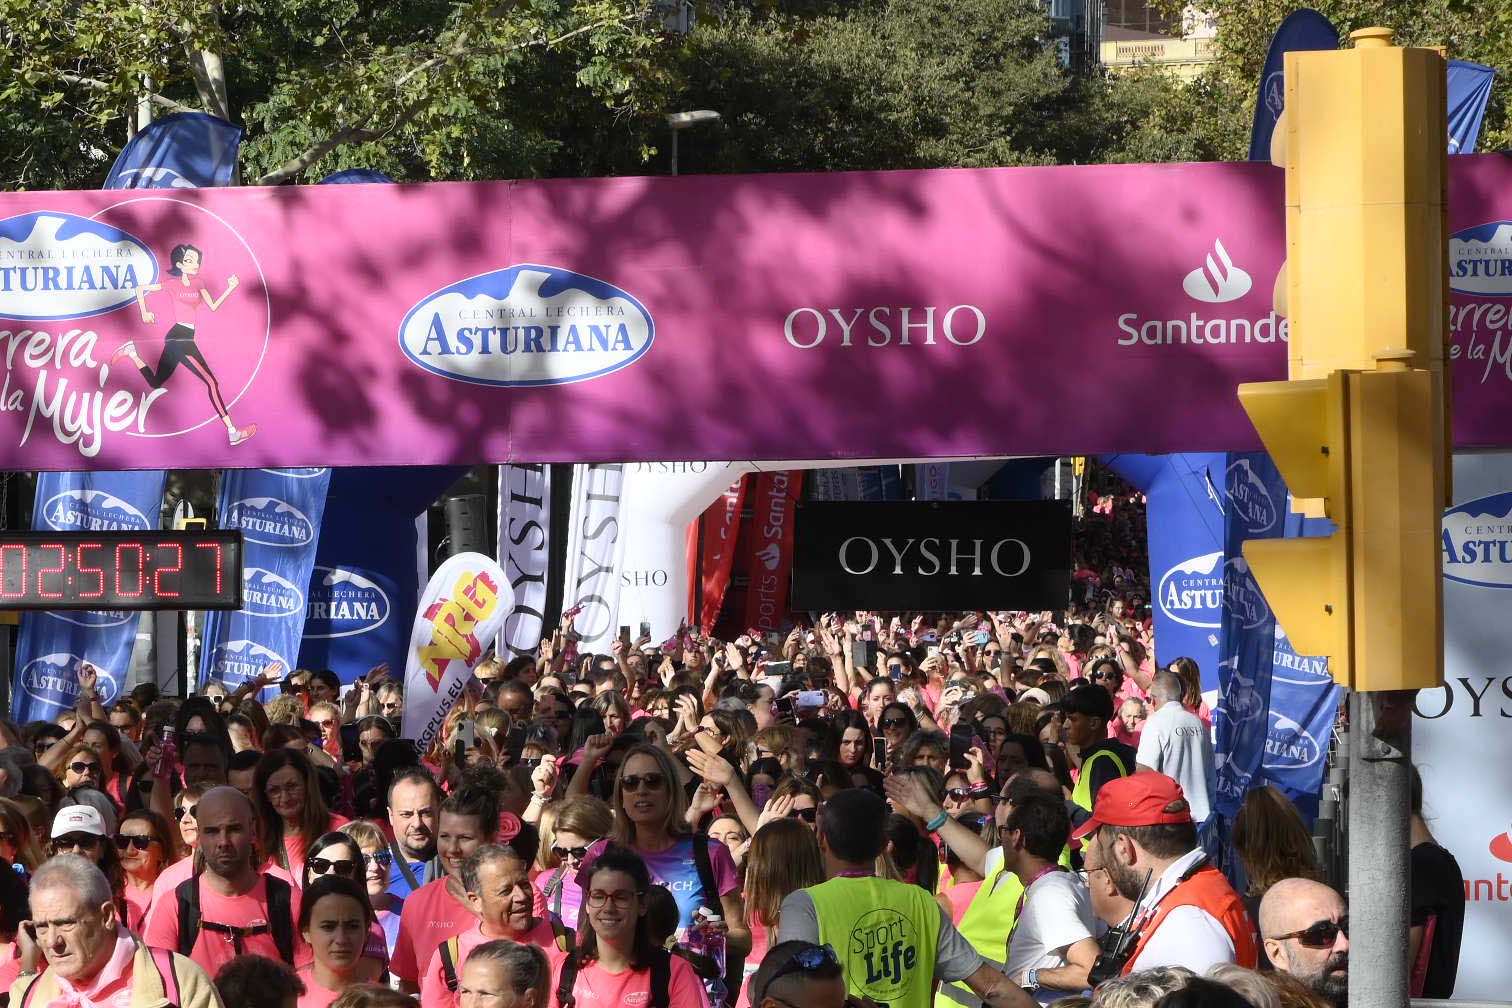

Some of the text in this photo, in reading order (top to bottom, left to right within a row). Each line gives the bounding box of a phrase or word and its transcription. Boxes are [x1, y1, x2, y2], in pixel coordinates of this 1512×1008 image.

[62, 248, 133, 259] LECHERA
[459, 306, 625, 319] CENTRAL LECHERA
[784, 304, 986, 349] OYSHO
[419, 312, 633, 355] ASTURIANA
[1118, 313, 1288, 346] Santande
[0, 372, 25, 412] la
[19, 370, 168, 457] Mujer
[229, 509, 307, 540] ASTURIANA
[1465, 526, 1512, 534] CENTR
[504, 463, 545, 657] OYSH
[571, 463, 623, 643] OYSH
[757, 471, 790, 630] ports Santa
[838, 537, 1031, 577] OYSHO
[0, 544, 221, 597] 02:50:27
[621, 570, 668, 587] SHO
[1182, 579, 1223, 587] CENTRA
[244, 589, 295, 610] URIANA
[306, 601, 380, 620] URIANA
[328, 590, 376, 598] LECHERA
[1272, 650, 1330, 677] URIANA
[853, 915, 907, 954] Sport
[864, 940, 916, 985] Life
